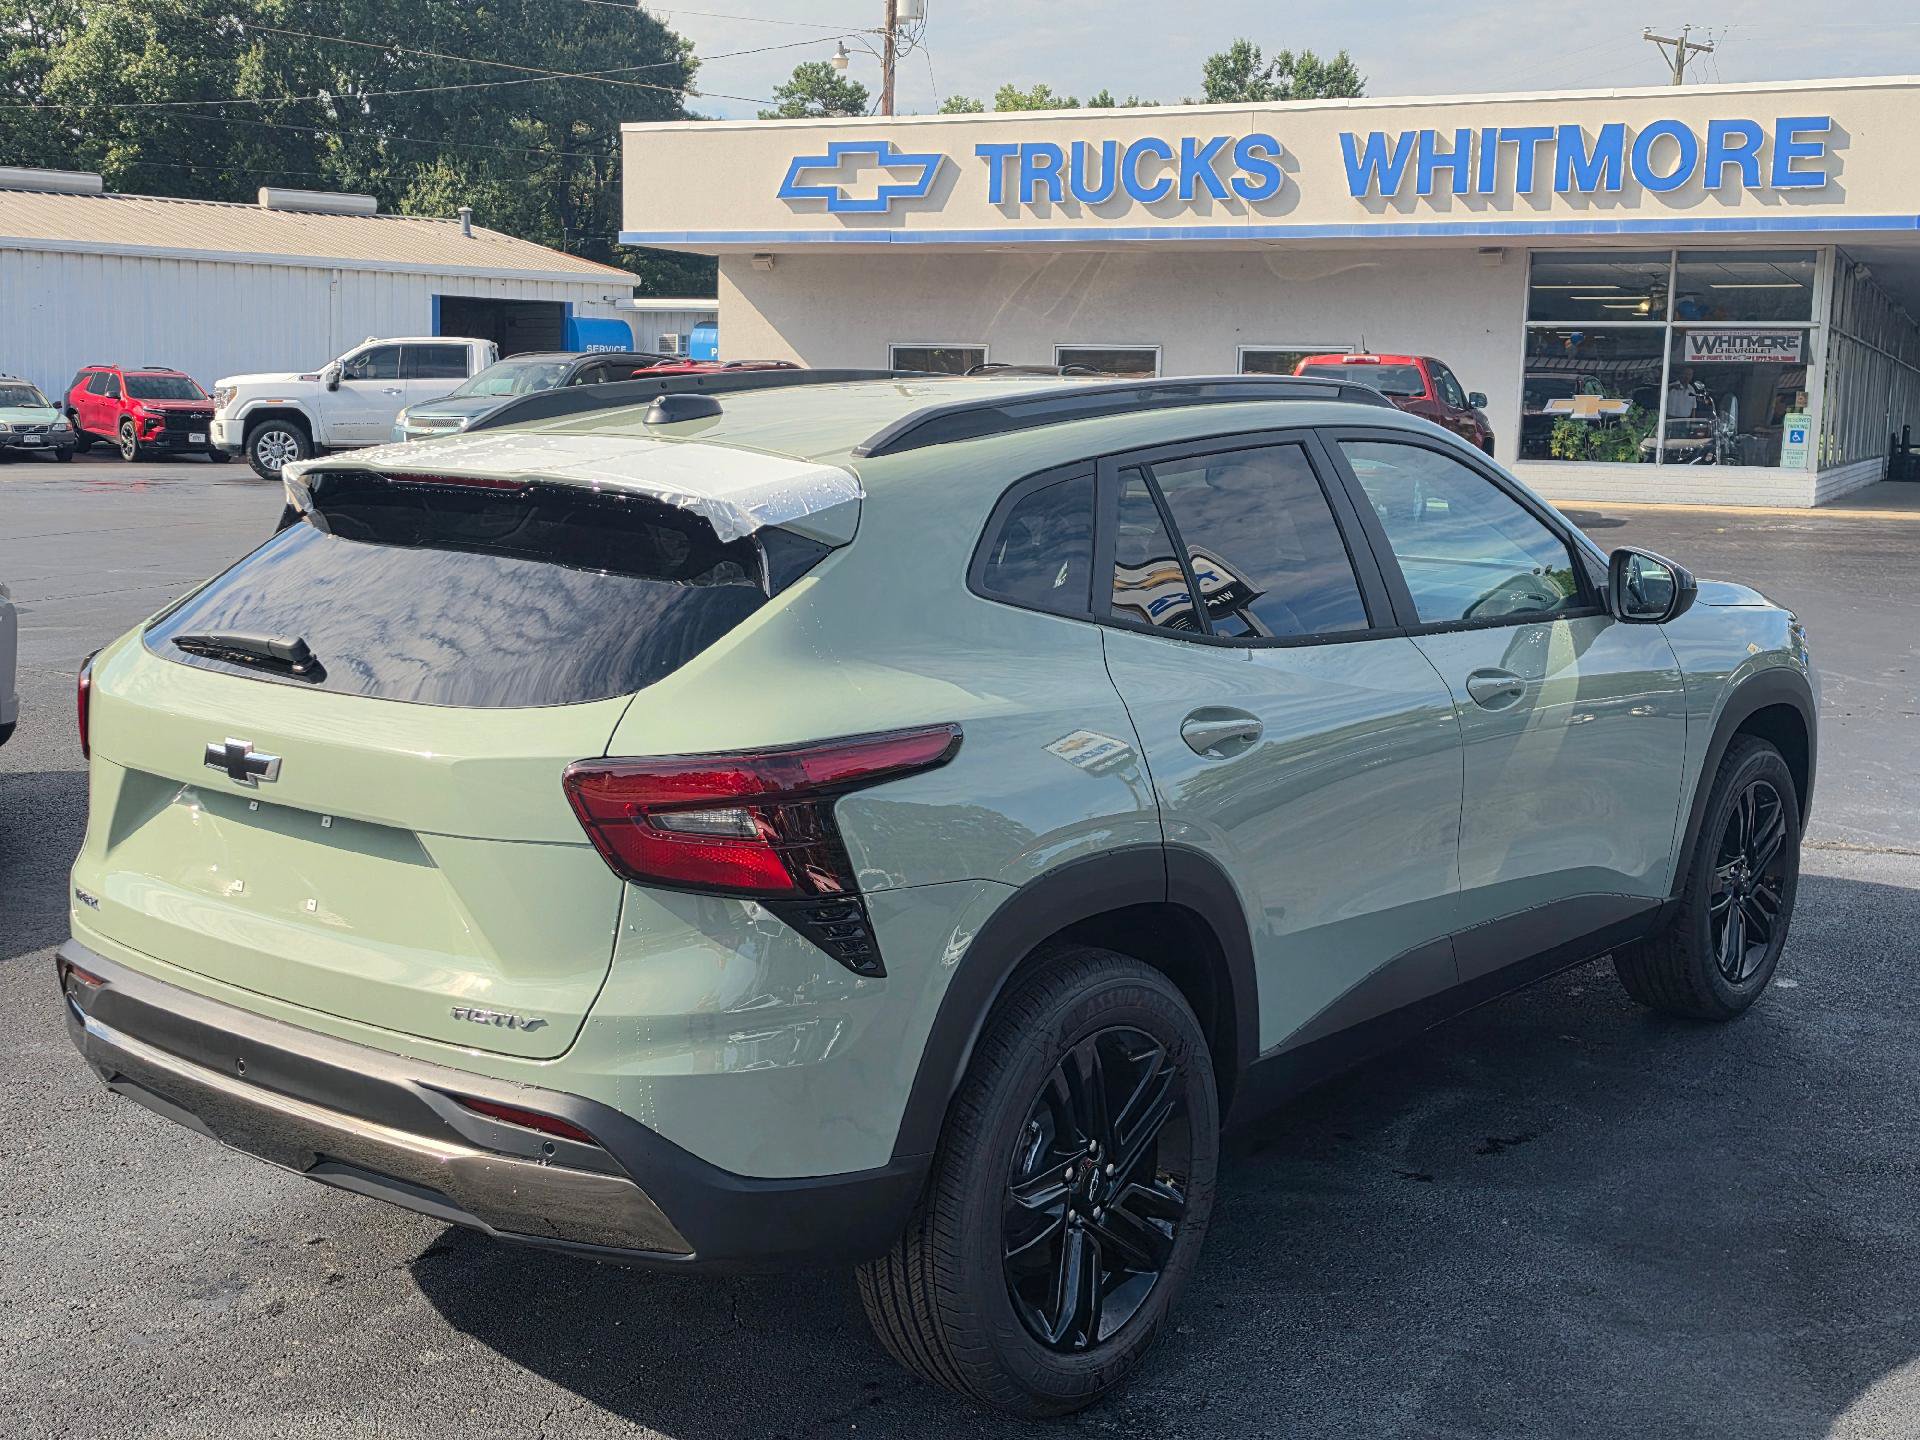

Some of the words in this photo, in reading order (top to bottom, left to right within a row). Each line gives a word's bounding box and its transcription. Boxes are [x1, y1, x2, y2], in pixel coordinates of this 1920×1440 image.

[975, 133, 1284, 204] TRUCKS
[1339, 116, 1832, 197] WHITMORE
[586, 344, 627, 353] SERVICE
[1690, 335, 1799, 354] WHITMORE
